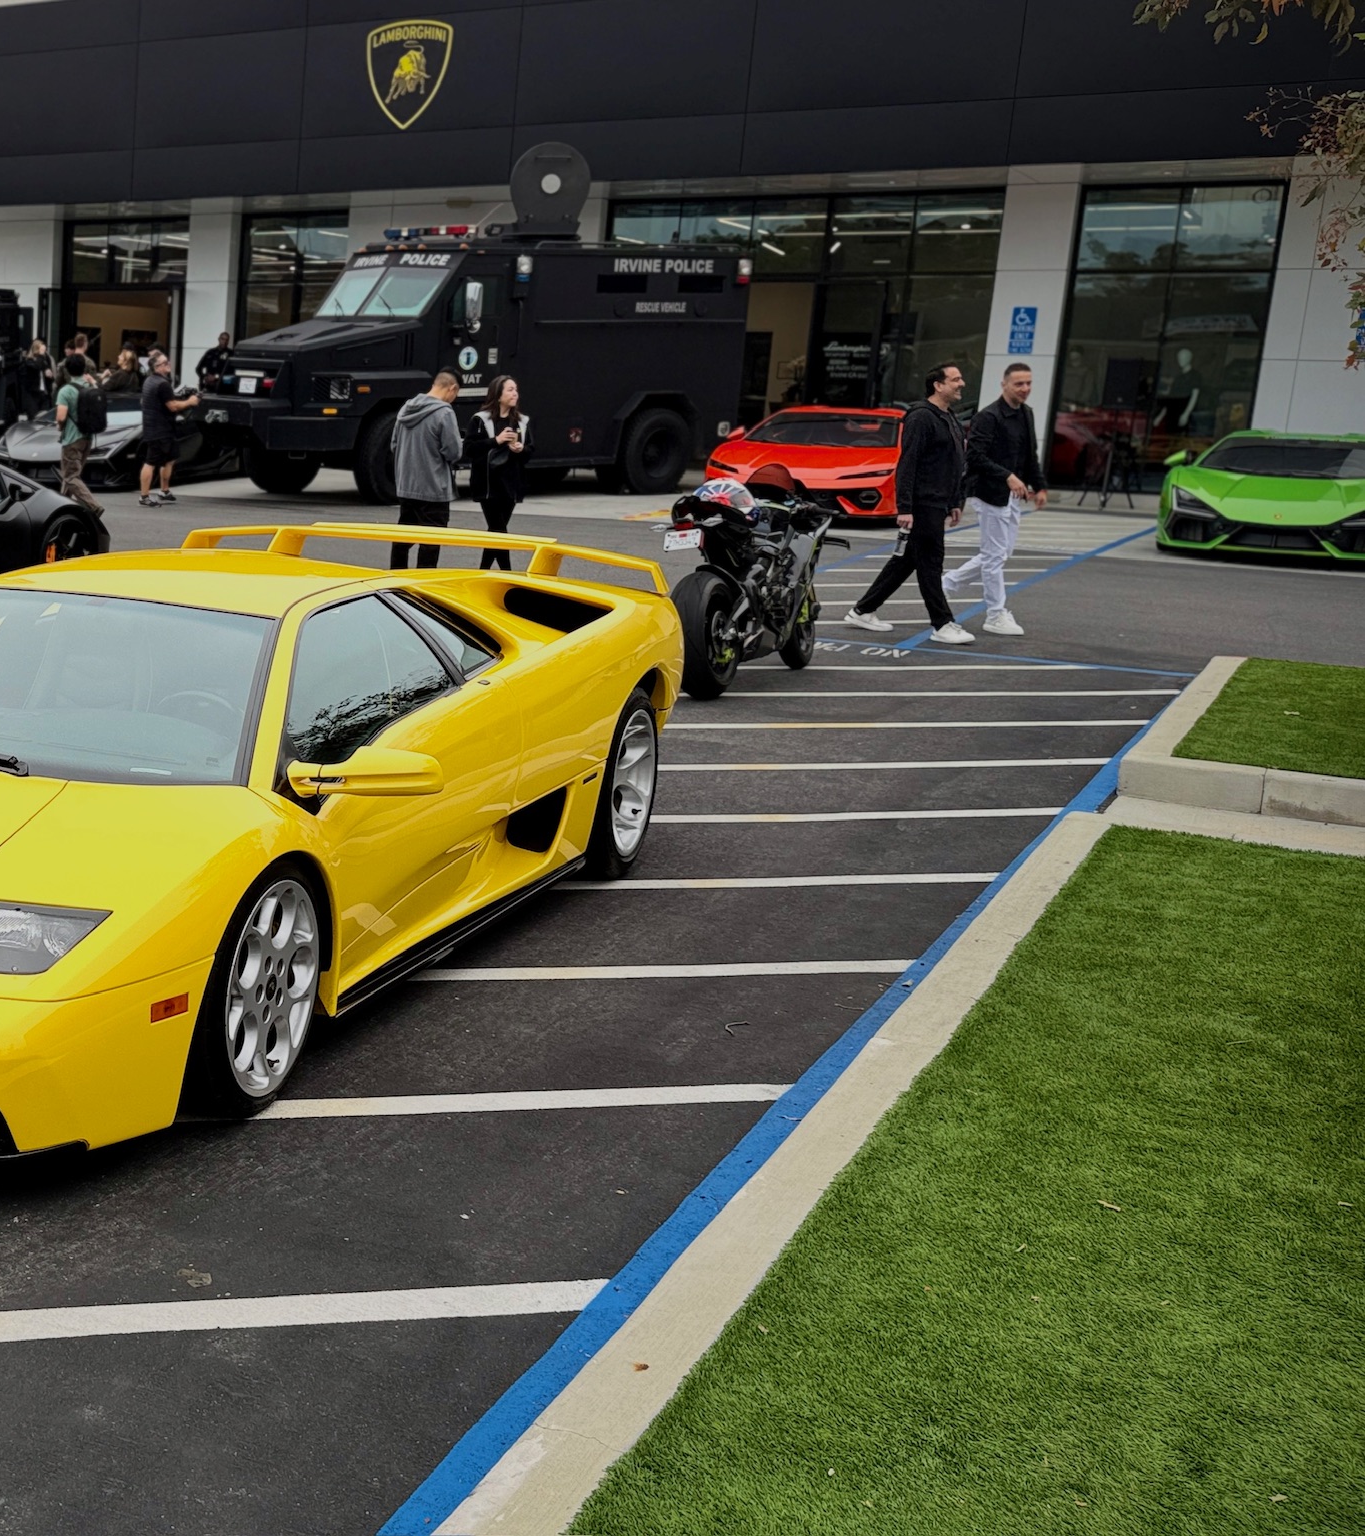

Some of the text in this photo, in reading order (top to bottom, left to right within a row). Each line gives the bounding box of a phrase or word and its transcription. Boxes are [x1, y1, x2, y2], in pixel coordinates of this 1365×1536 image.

[373, 26, 447, 48] LAMBORGHINI
[353, 253, 452, 268] IRVINE POLICE
[614, 258, 714, 273] IRVINE POLICE
[635, 302, 687, 313] RESCUE VEHICLE
